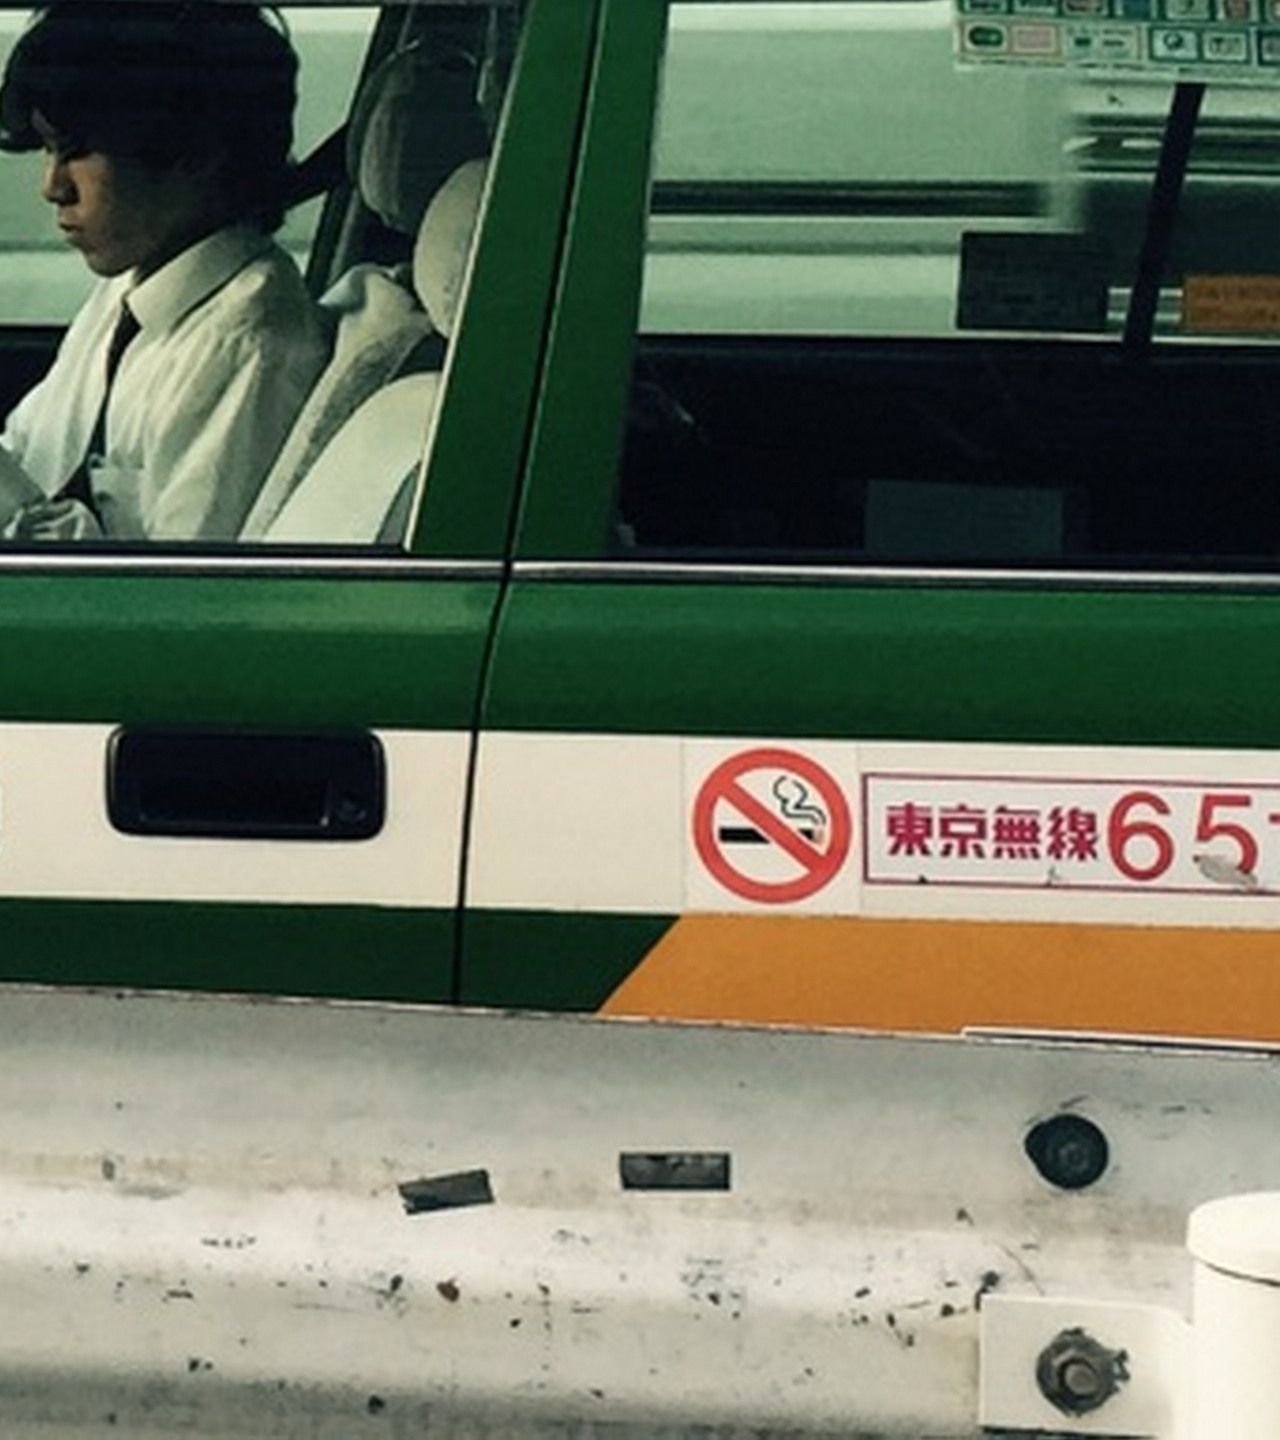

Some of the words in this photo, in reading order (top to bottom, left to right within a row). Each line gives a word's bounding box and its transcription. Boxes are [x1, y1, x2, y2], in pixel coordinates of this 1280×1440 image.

[886, 801, 1098, 862] 東京無線
[1107, 790, 1280, 882] 65
